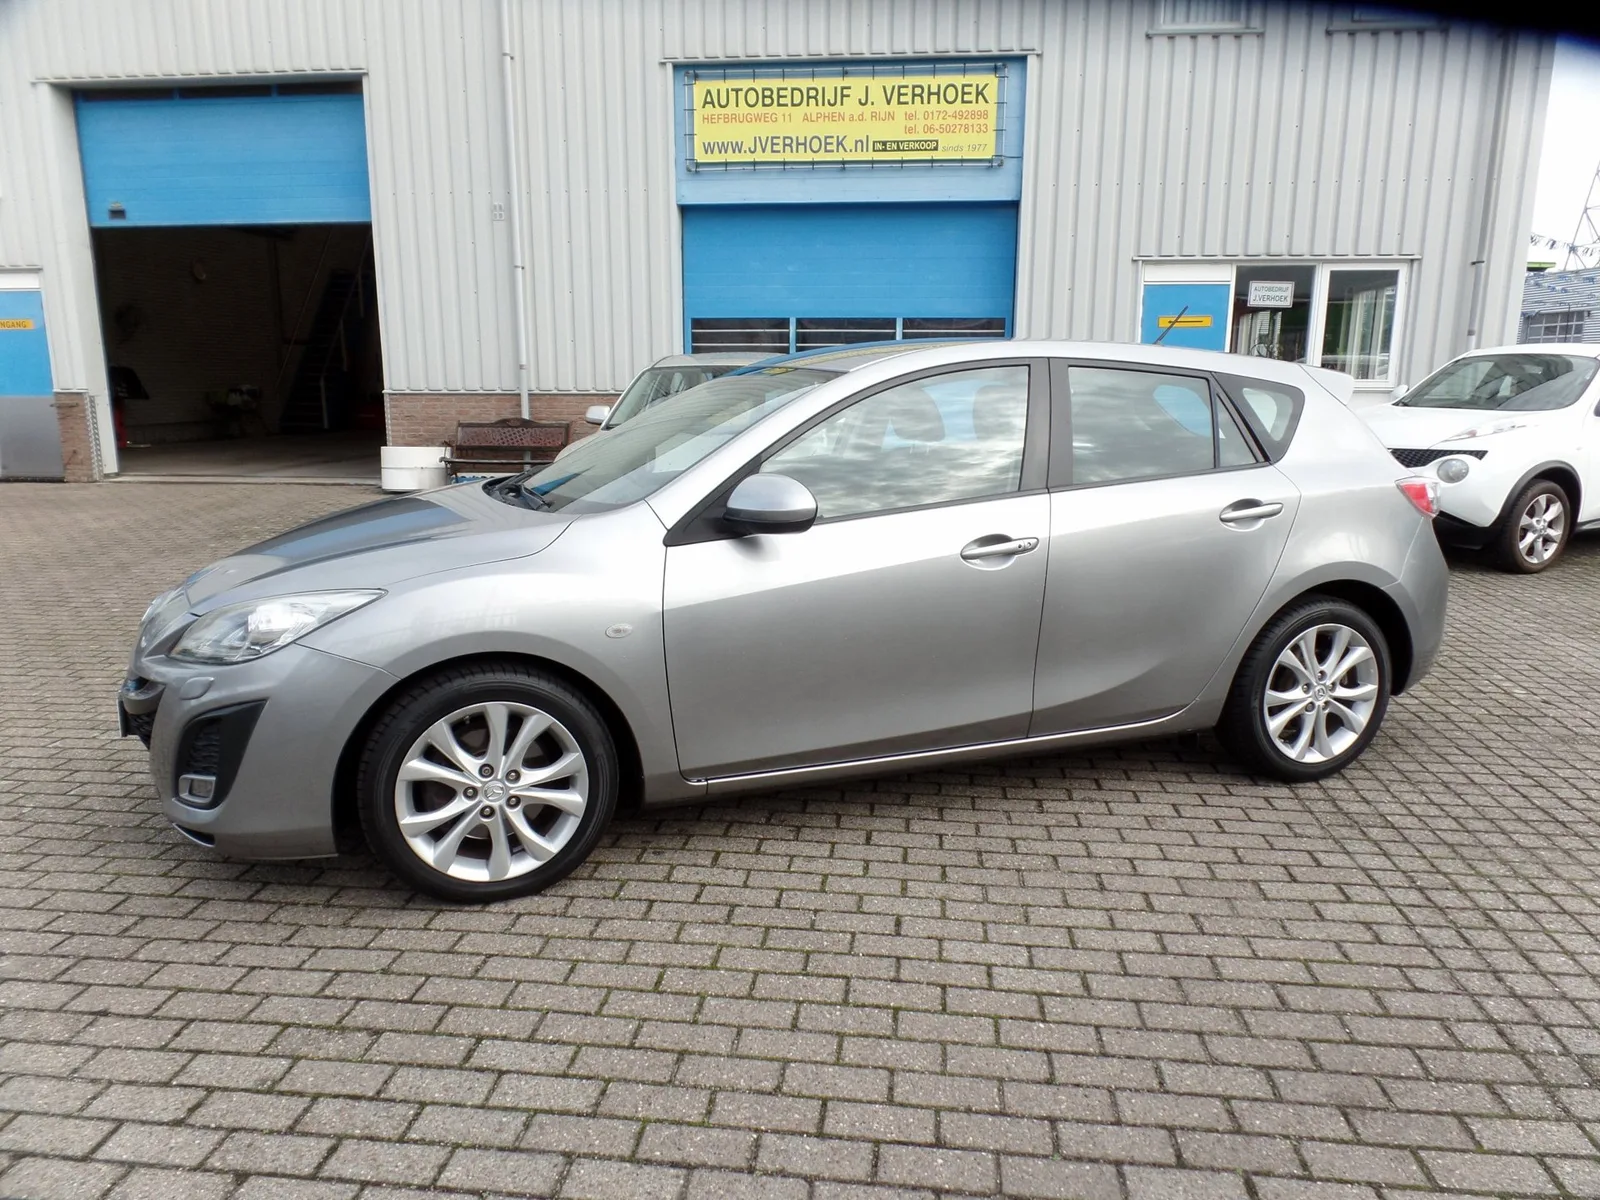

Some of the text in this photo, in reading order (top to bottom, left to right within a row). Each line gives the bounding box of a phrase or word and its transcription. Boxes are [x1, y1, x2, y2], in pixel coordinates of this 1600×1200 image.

[702, 83, 990, 109] AUTOBEDRIJF J. VERHOEK
[702, 109, 989, 124] HEFBRUGWEG 11 ALPHEN a.d. RIJN tel. 0172-492898
[904, 123, 989, 135] tel. 06-50278133
[702, 135, 869, 155] www.JVERHOEK.nl
[887, 141, 899, 151] EN
[899, 140, 937, 151] VERKOOP
[942, 143, 988, 153] sinds 1977
